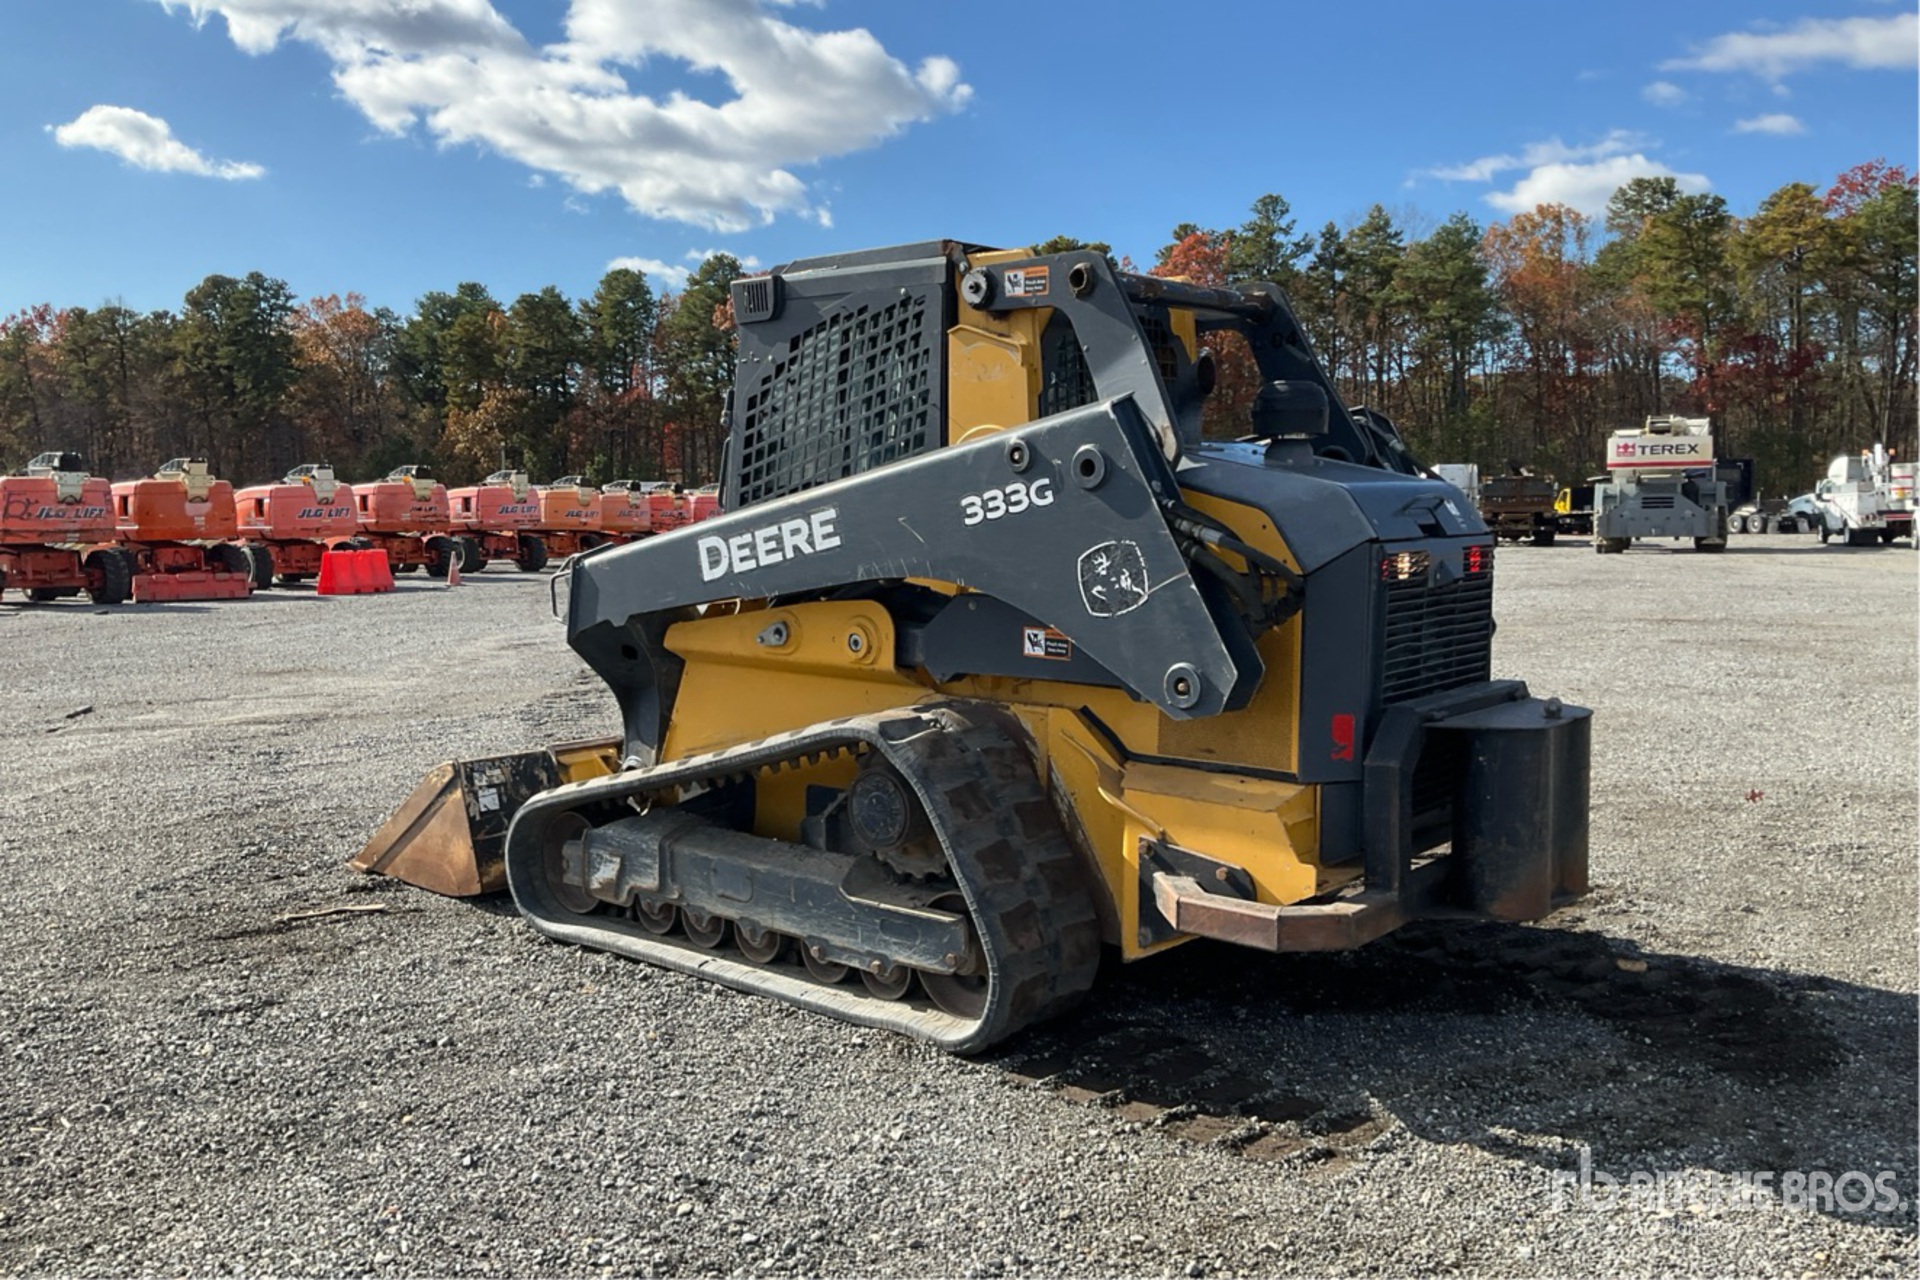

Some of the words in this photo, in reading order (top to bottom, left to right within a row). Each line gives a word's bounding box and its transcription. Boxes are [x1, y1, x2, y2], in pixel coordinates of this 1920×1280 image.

[1638, 444, 1699, 455] TEREX
[961, 478, 1054, 526] 333G
[297, 508, 324, 518] JLG
[328, 507, 350, 518] LIFT
[498, 505, 518, 514] JLG
[521, 505, 537, 514] LIFT
[697, 508, 842, 582] DEERE
